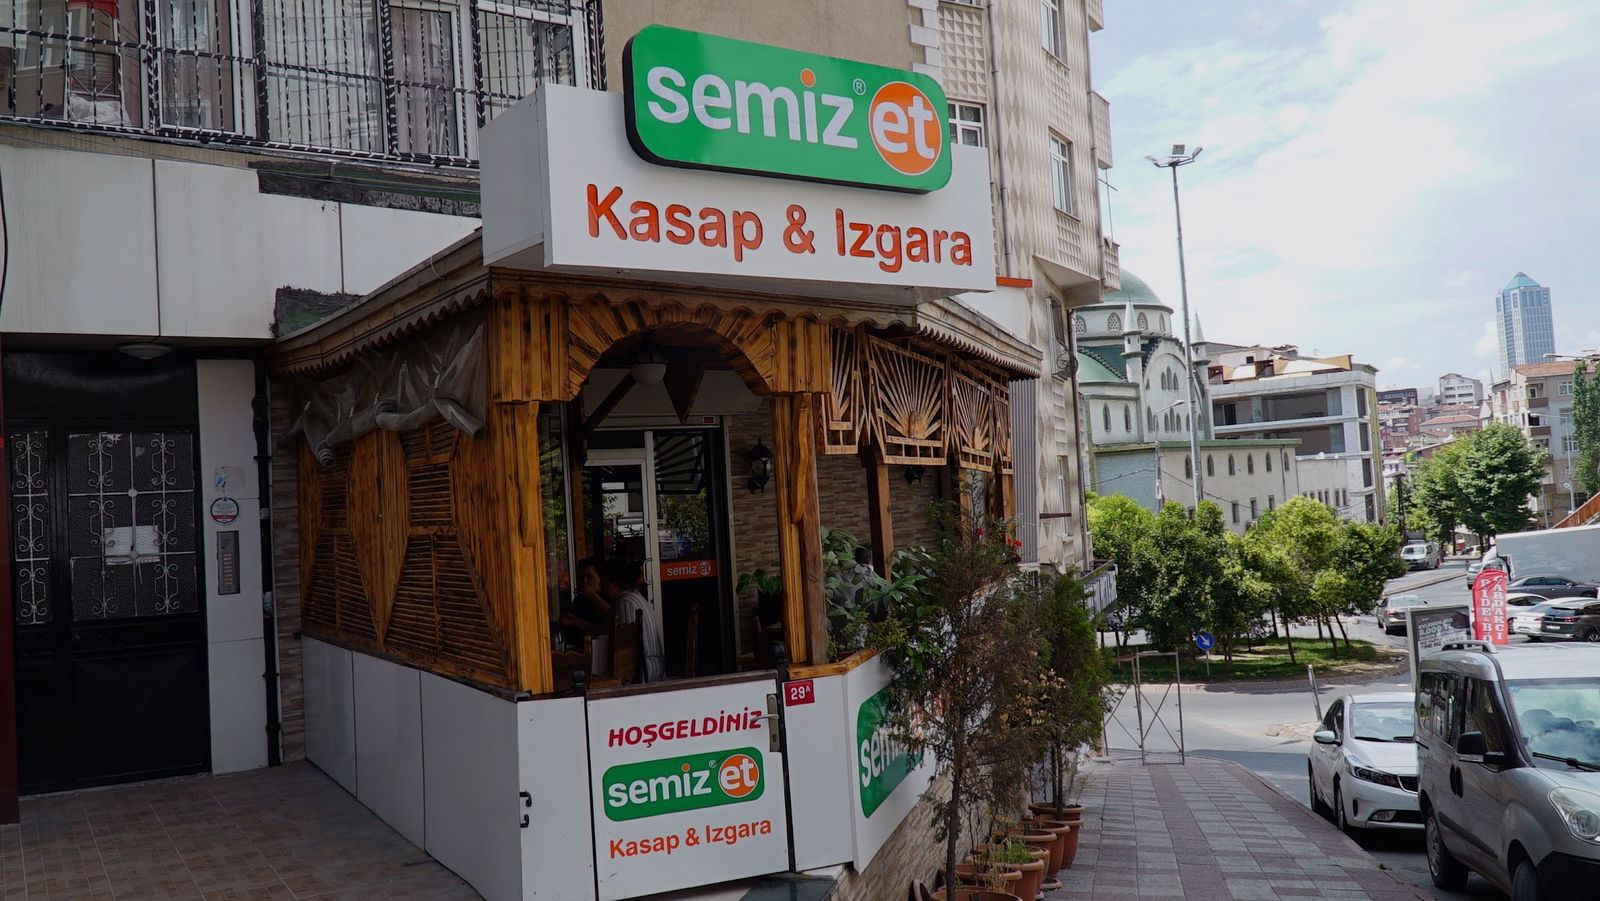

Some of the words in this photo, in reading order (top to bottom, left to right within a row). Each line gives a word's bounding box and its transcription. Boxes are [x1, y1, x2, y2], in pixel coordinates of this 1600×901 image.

[647, 66, 858, 149] semiz
[872, 95, 935, 160] et
[586, 183, 763, 262] Kasap
[782, 204, 816, 255] &
[835, 208, 972, 273] Izgara
[666, 563, 698, 576] semiz
[608, 706, 762, 748] HOŞGELDİNİZ
[608, 763, 712, 808] semiz
[720, 758, 756, 790] et
[609, 834, 679, 859] Kasap
[685, 827, 700, 847] &
[705, 819, 772, 845] Izgara
